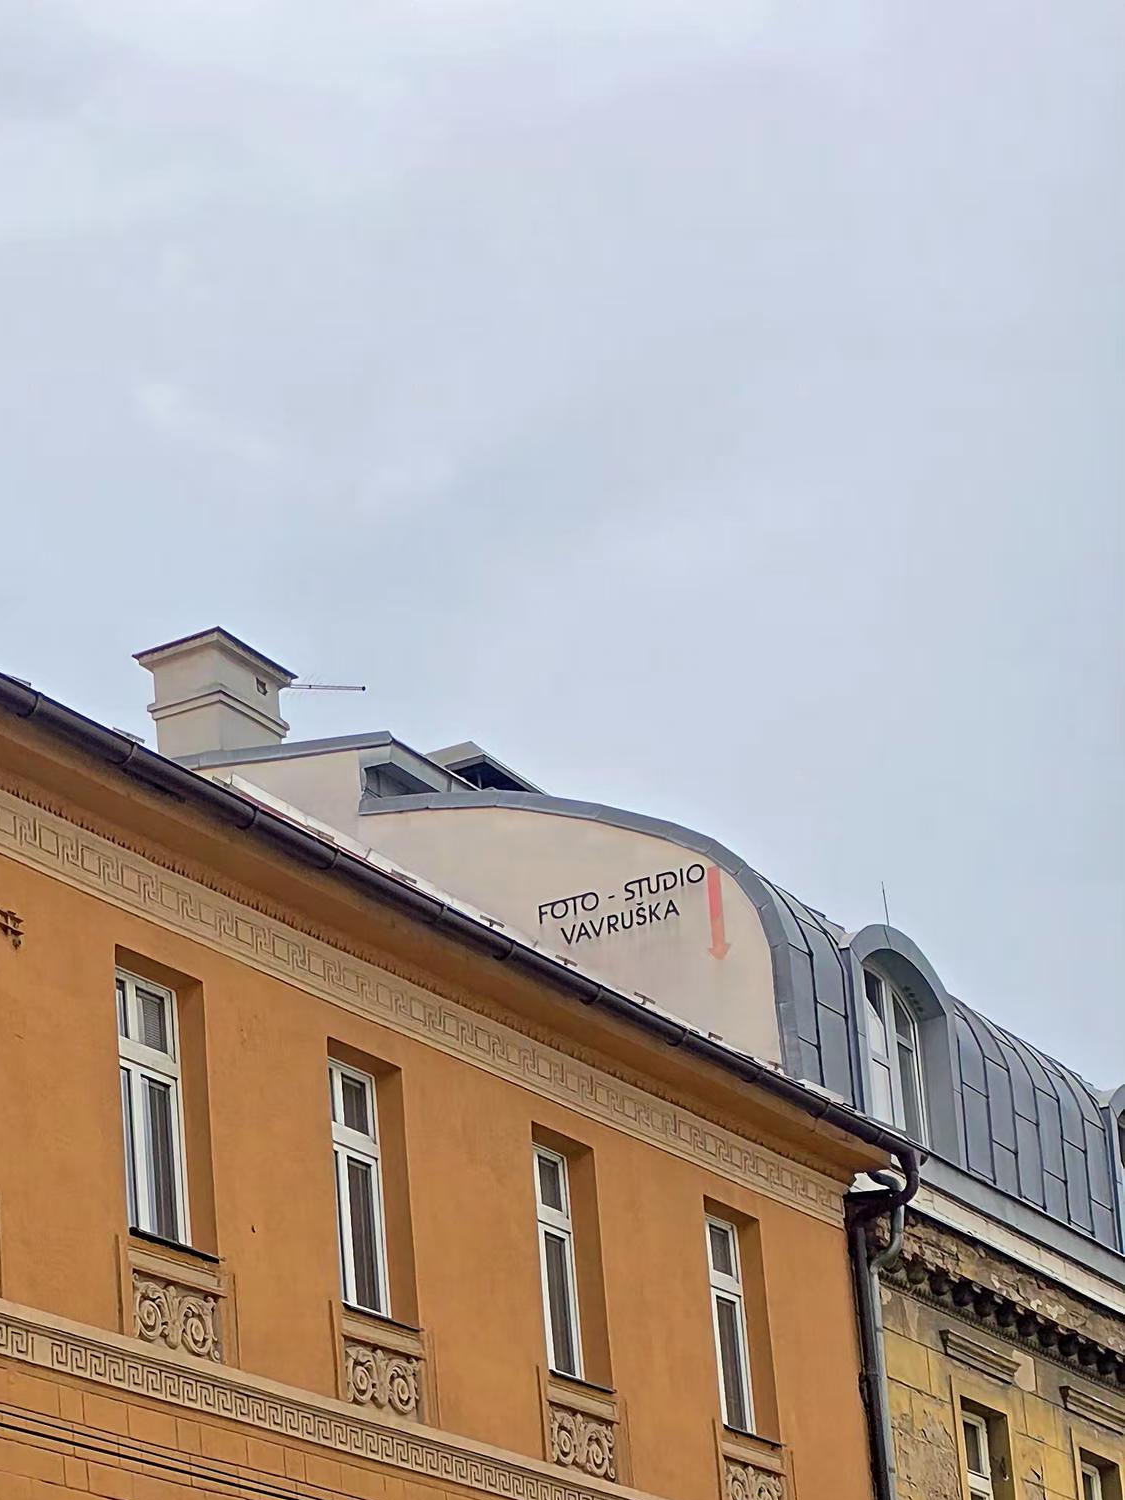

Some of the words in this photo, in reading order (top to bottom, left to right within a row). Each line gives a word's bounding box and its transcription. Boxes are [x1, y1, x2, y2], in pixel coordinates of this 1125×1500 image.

[538, 892, 599, 925] FOTO
[624, 863, 705, 901] STUDIO
[560, 900, 680, 945] VAVRUŠKA
